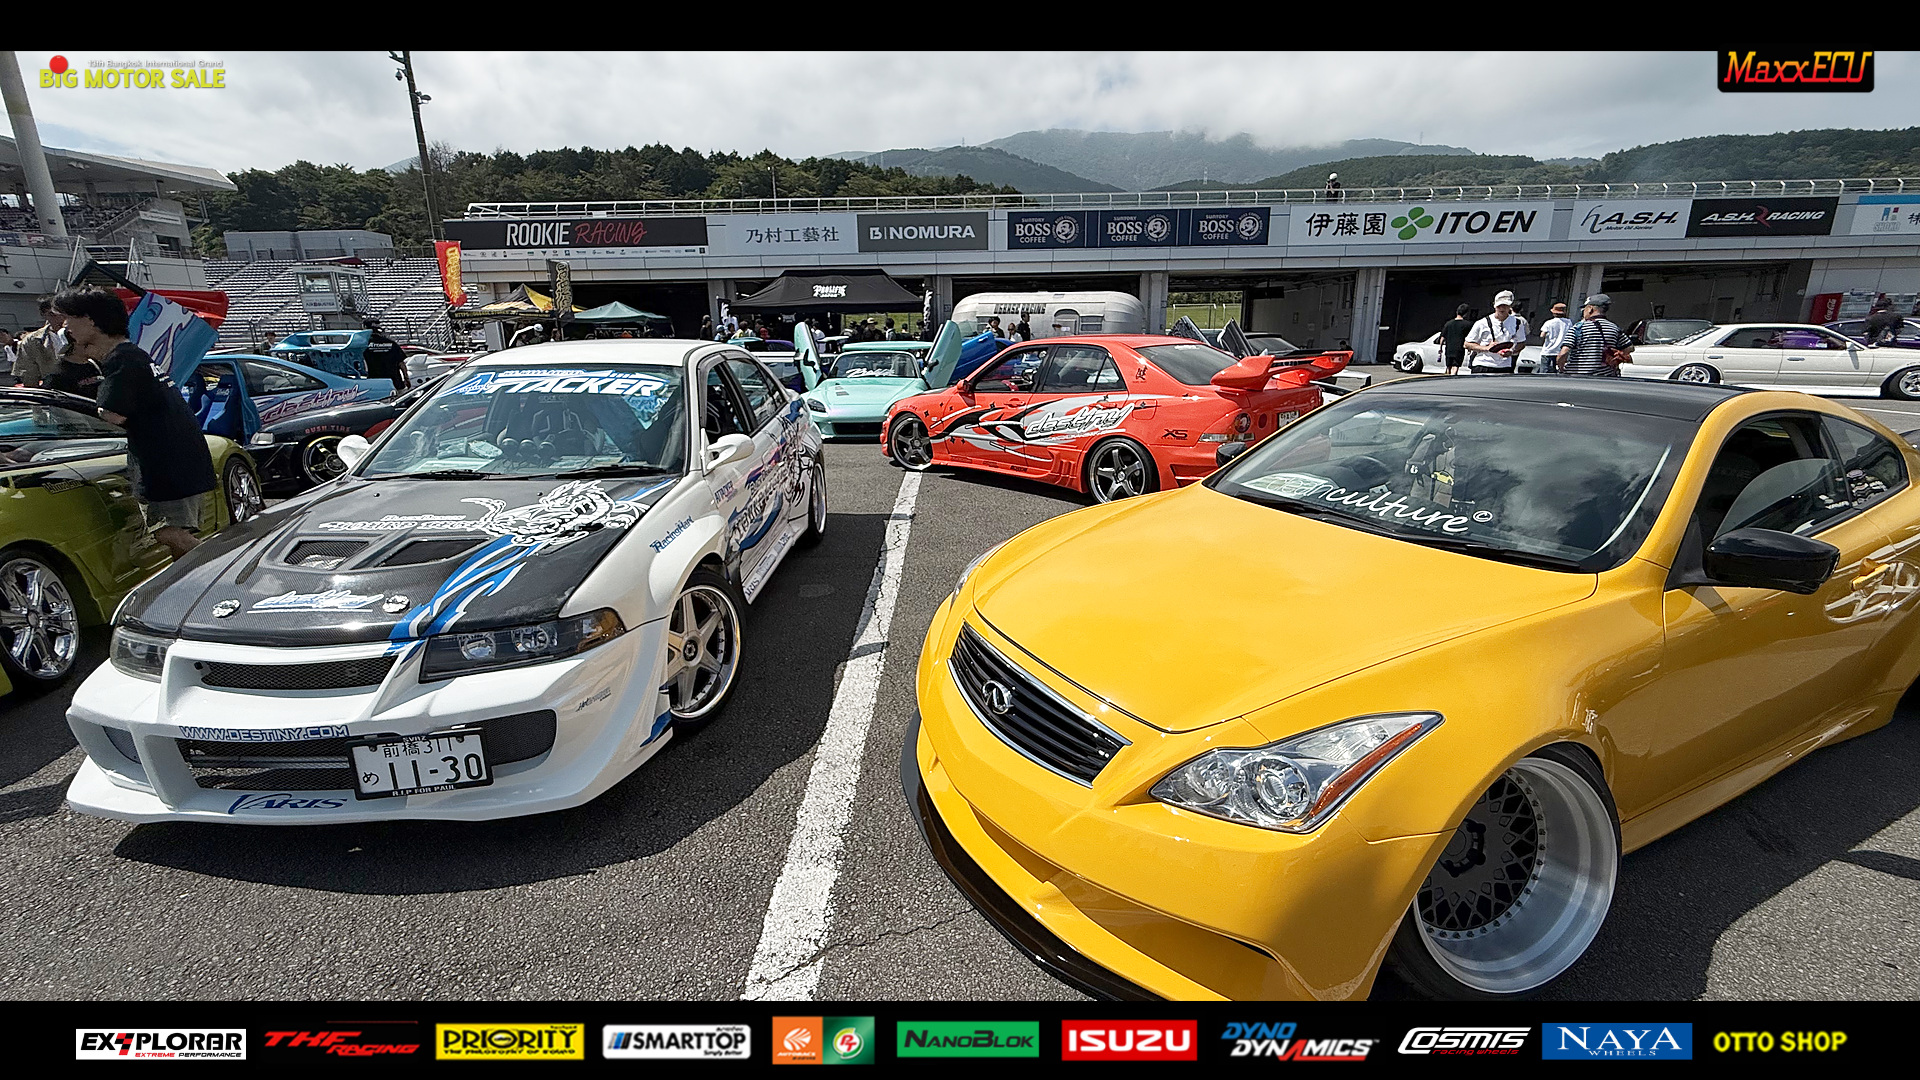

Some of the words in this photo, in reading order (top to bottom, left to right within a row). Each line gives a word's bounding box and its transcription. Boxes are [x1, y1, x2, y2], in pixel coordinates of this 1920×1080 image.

[1767, 211, 1826, 221] RACING
[1015, 223, 1051, 236] BOSS
[1106, 221, 1143, 235] BOSS
[1198, 220, 1235, 233] BOSS
[1306, 212, 1387, 236] 伊藤園
[506, 222, 571, 246] ROOKIE
[574, 221, 648, 245] RACING
[889, 226, 976, 240] NOMURA
[1202, 233, 1229, 241] COFFEE
[179, 725, 350, 742] WWW.DESTINY.COM
[382, 742, 420, 758] 前橋
[423, 737, 453, 754] 311
[362, 772, 380, 786] め
[388, 753, 483, 789] 11-30
